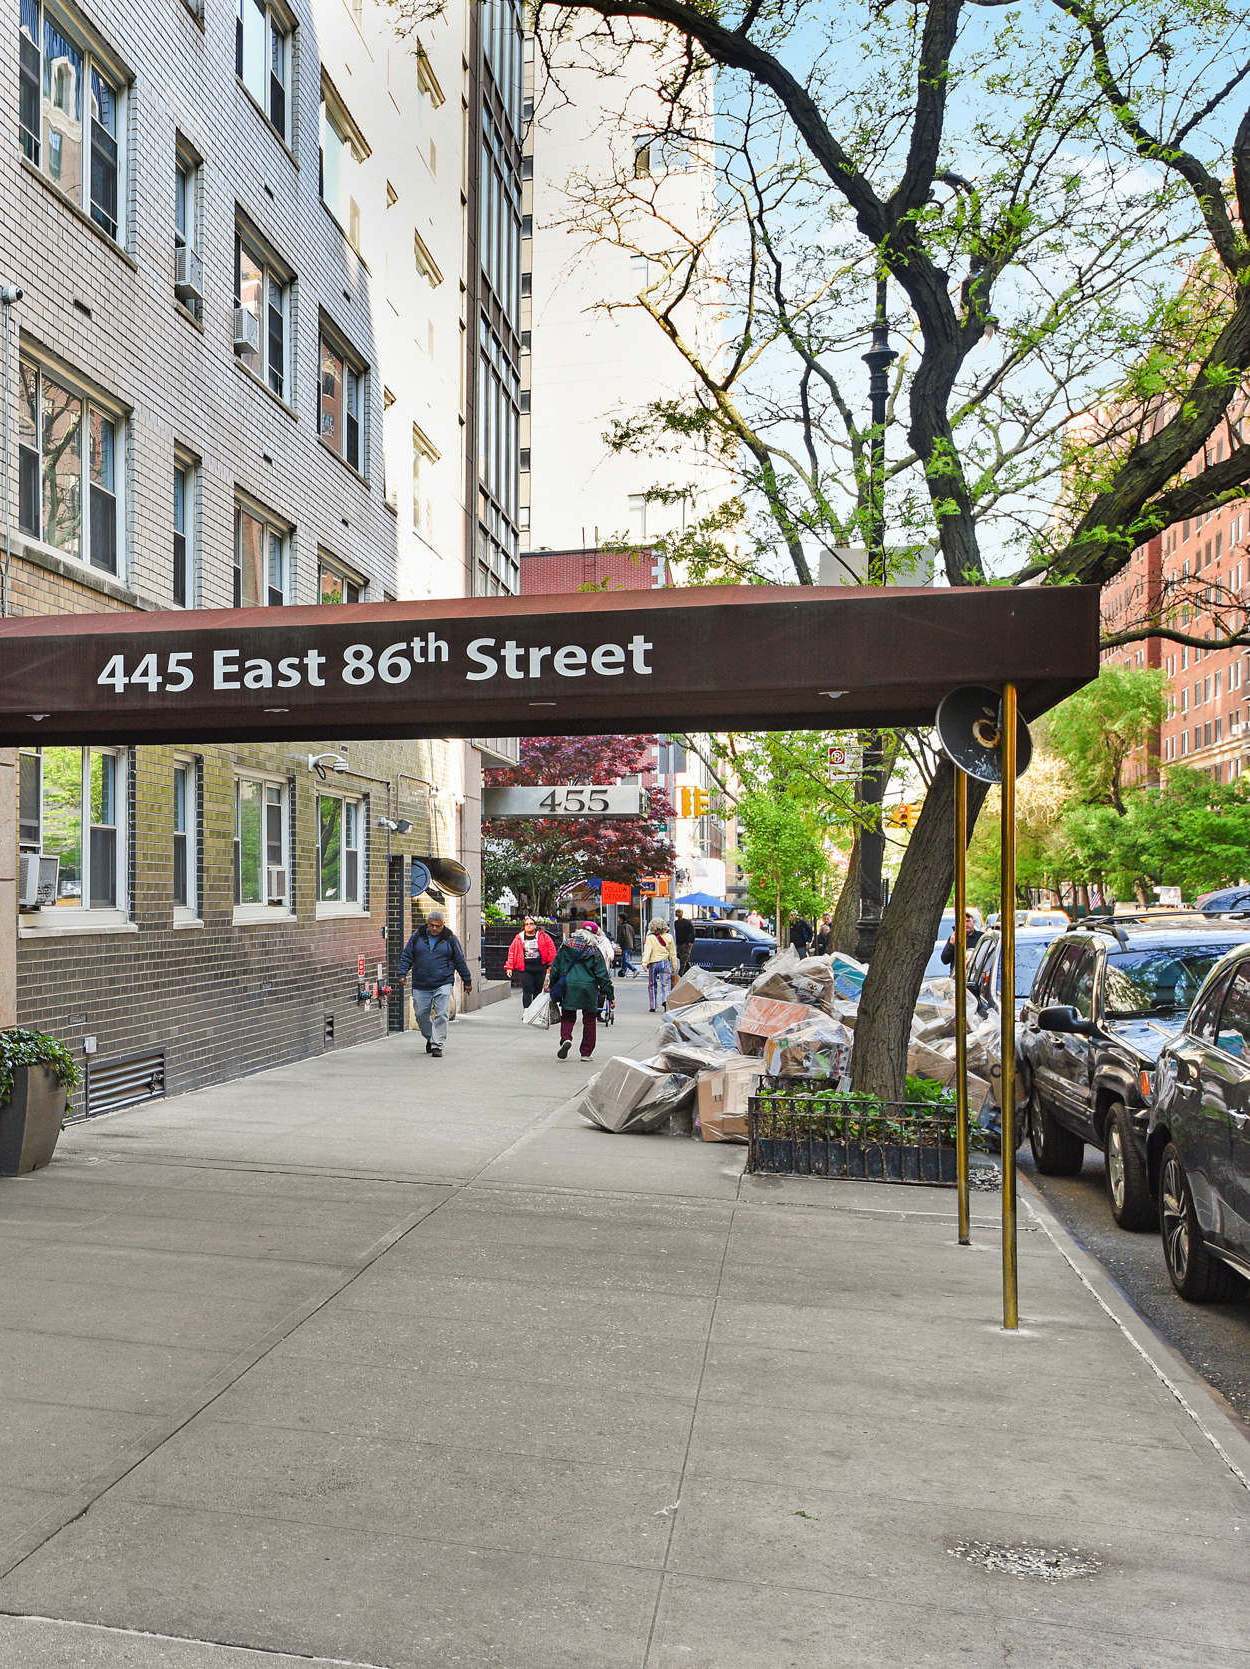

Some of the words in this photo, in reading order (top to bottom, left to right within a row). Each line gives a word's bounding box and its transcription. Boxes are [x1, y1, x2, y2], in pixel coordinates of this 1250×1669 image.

[97, 652, 195, 693] 445
[213, 649, 327, 690] East
[341, 632, 449, 685] 86th
[465, 635, 654, 681] Street
[539, 788, 610, 812] 455
[604, 893, 628, 901] DETOUR
